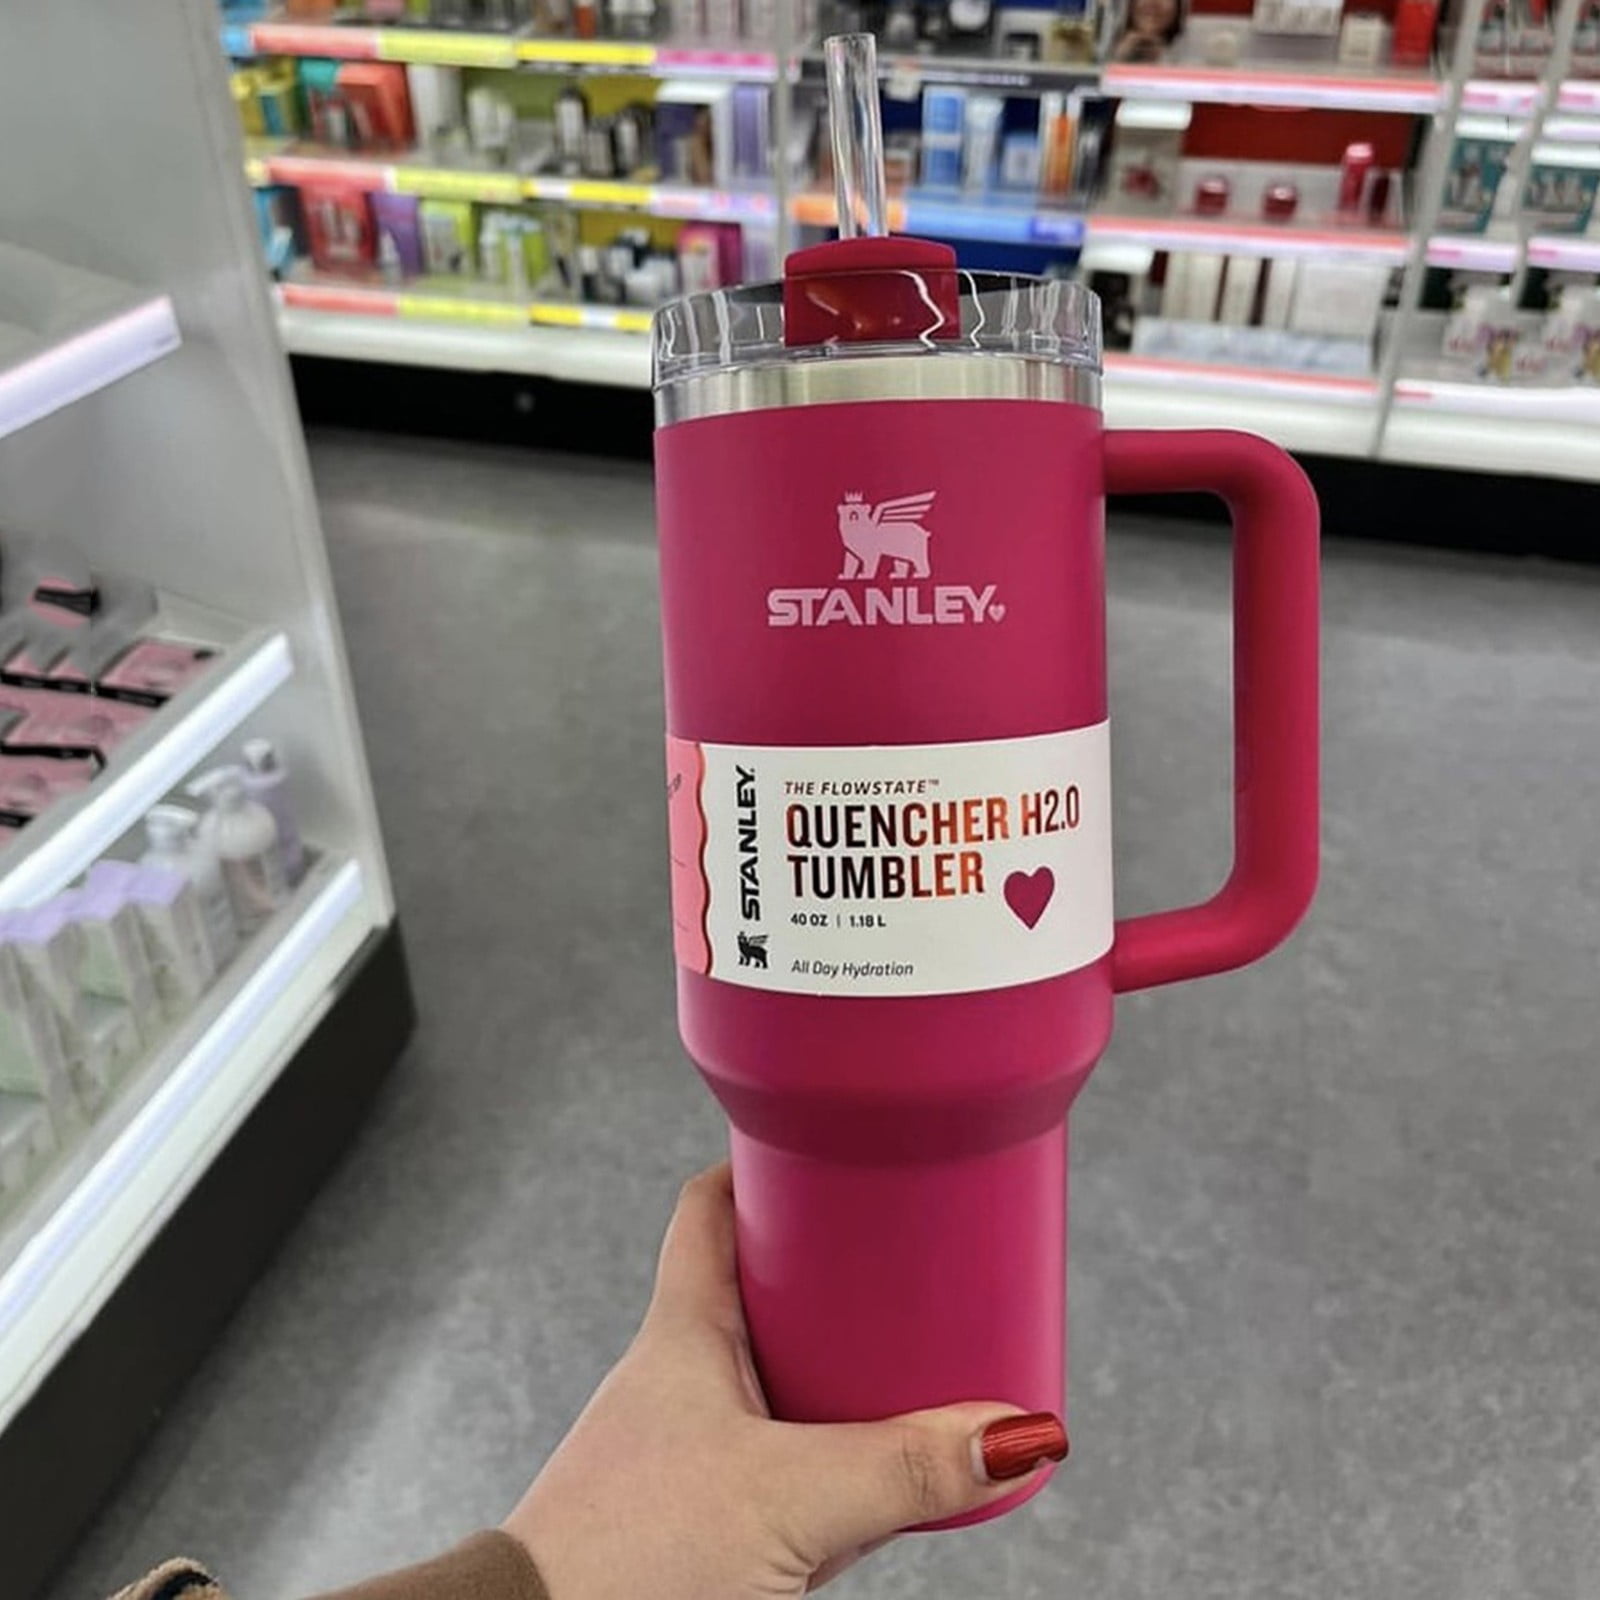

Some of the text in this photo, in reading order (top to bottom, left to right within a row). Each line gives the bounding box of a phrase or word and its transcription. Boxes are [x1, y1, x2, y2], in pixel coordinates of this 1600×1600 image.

[767, 585, 997, 626] STANLEY
[785, 781, 815, 795] THE
[786, 785, 1080, 848] QUENCHER H2.0
[787, 851, 984, 899] TUMBLER
[790, 913, 886, 928] 40 OZ 1.18 L
[791, 960, 914, 979] All Day Hydration
